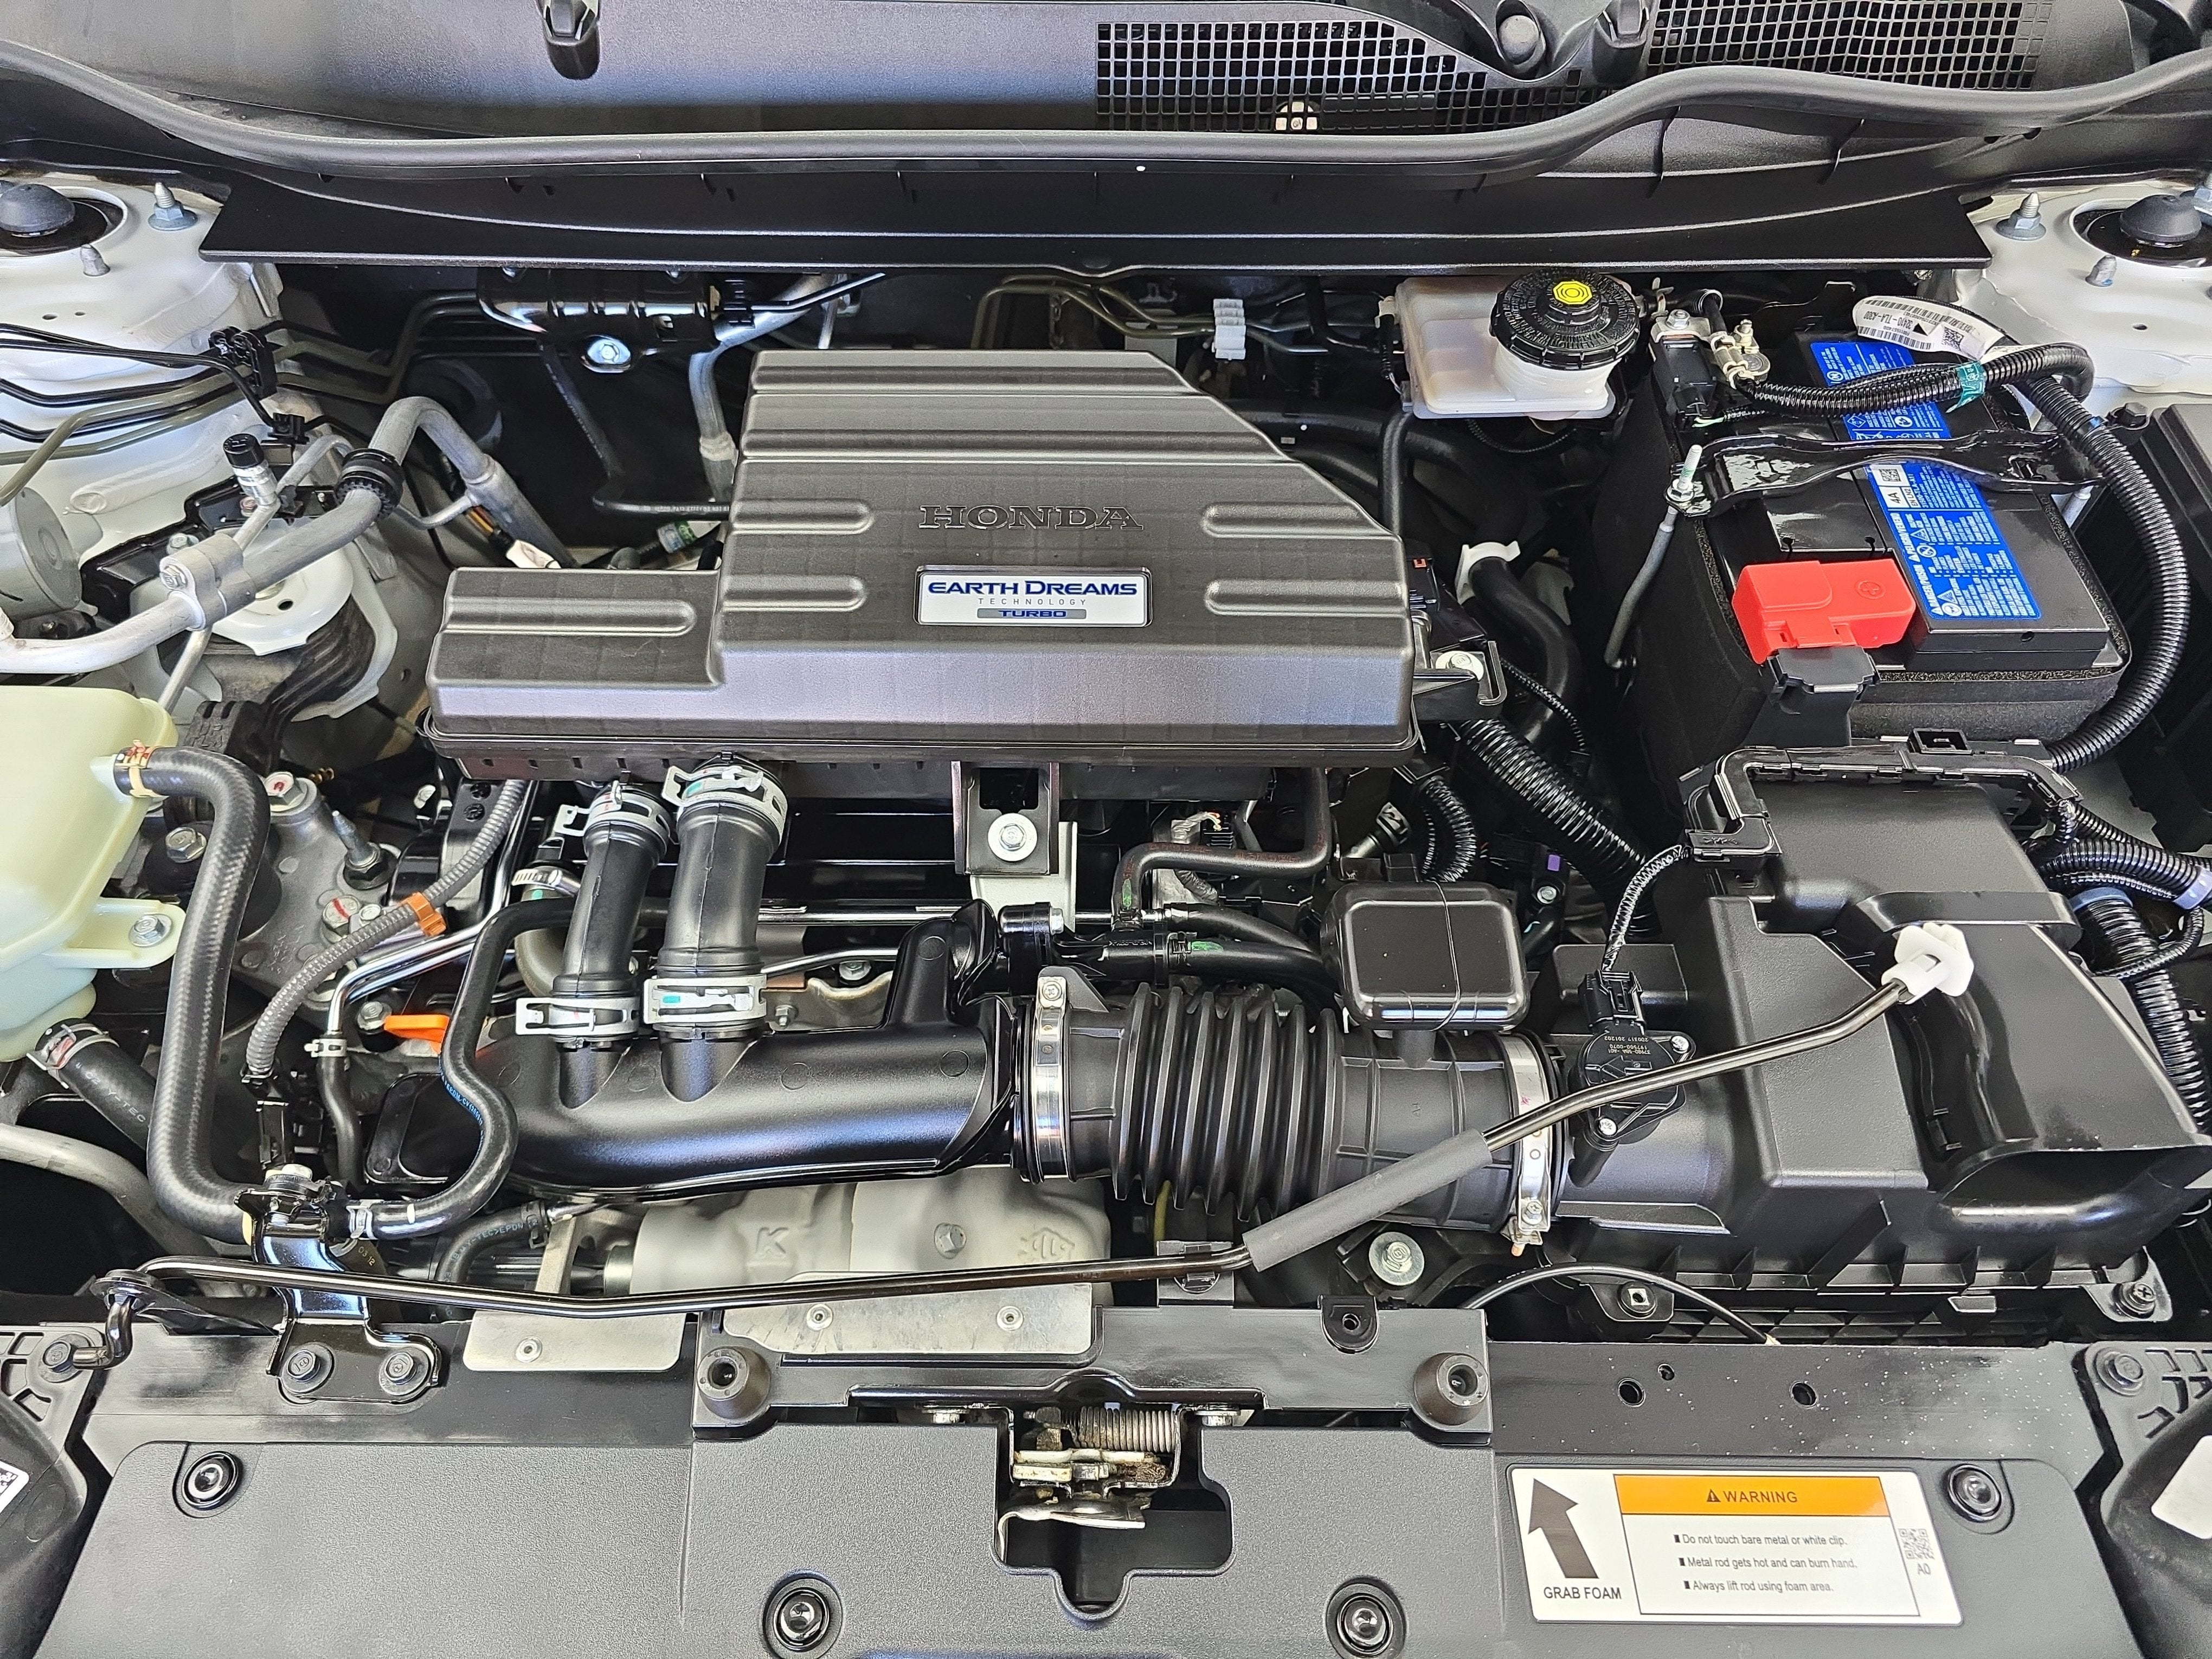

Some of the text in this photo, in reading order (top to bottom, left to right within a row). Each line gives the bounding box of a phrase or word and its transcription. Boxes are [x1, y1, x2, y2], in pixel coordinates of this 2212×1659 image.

[1908, 474, 1928, 507] 31500-TLA-A11
[1888, 492, 1901, 504] 4A
[1911, 498, 1918, 506] EN
[919, 505, 1143, 530] HONDA
[928, 580, 1137, 595] EARTH DREAMS
[107, 1088, 146, 1122] Y-TEC
[358, 1246, 376, 1266] 03 12
[1723, 1491, 1797, 1503] WARNING
[1682, 1534, 1695, 1544] Do
[1698, 1535, 1713, 1544] not
[1714, 1535, 1739, 1544] touch
[1741, 1535, 1761, 1544] bare
[1764, 1535, 1789, 1544] metal
[1803, 1535, 1827, 1545] white
[1829, 1535, 1848, 1547] clip.
[1687, 1557, 1713, 1566] Metal
[1715, 1558, 1730, 1567] rod
[1732, 1558, 1752, 1569] gets
[1753, 1558, 1769, 1567] hot
[1771, 1558, 1787, 1567] and
[1808, 1558, 1829, 1568] burn
[1830, 1558, 1857, 1568] hand.
[1544, 1587, 1621, 1599] GRAB FOAM
[1694, 1580, 1725, 1592] Always
[1726, 1580, 1739, 1591] lift
[1740, 1581, 1756, 1590] rod
[1758, 1581, 1783, 1593] using
[1785, 1581, 1808, 1591] foam
